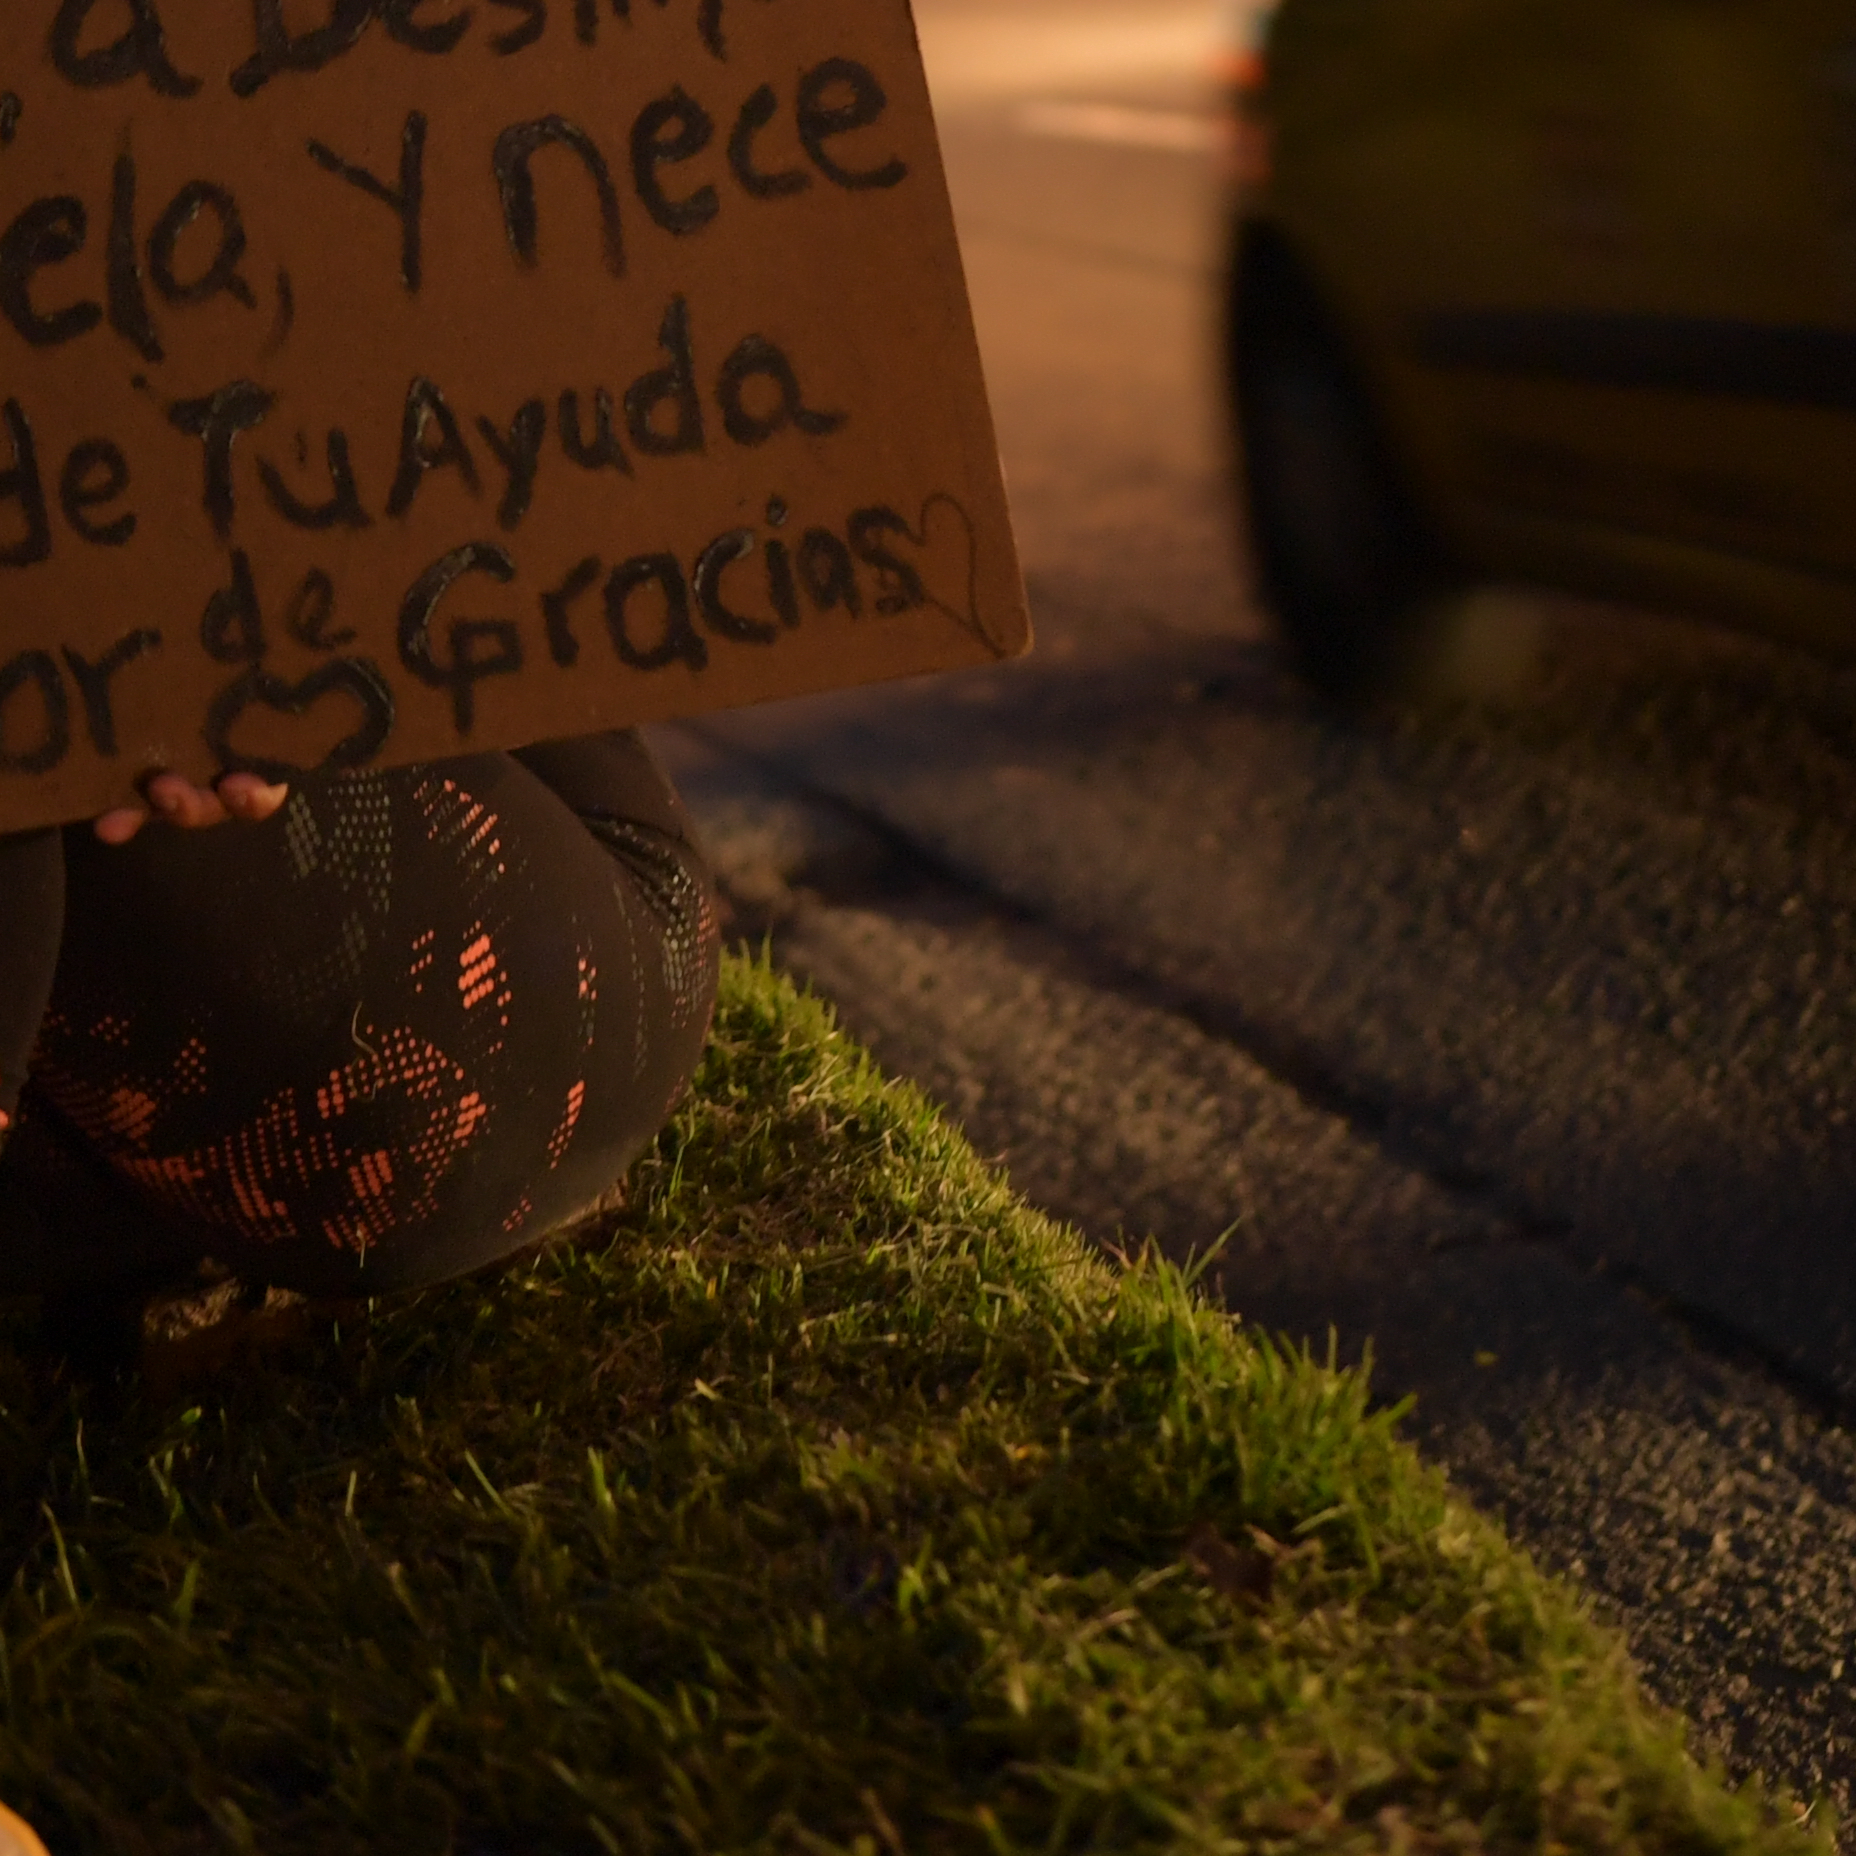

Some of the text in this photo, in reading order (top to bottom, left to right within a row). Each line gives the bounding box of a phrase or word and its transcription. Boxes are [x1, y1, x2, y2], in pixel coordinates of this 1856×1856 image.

[494, 56, 906, 278] nece
[386, 294, 850, 532] Ayuda
[199, 549, 359, 666] de
[396, 492, 926, 736] Gracias
